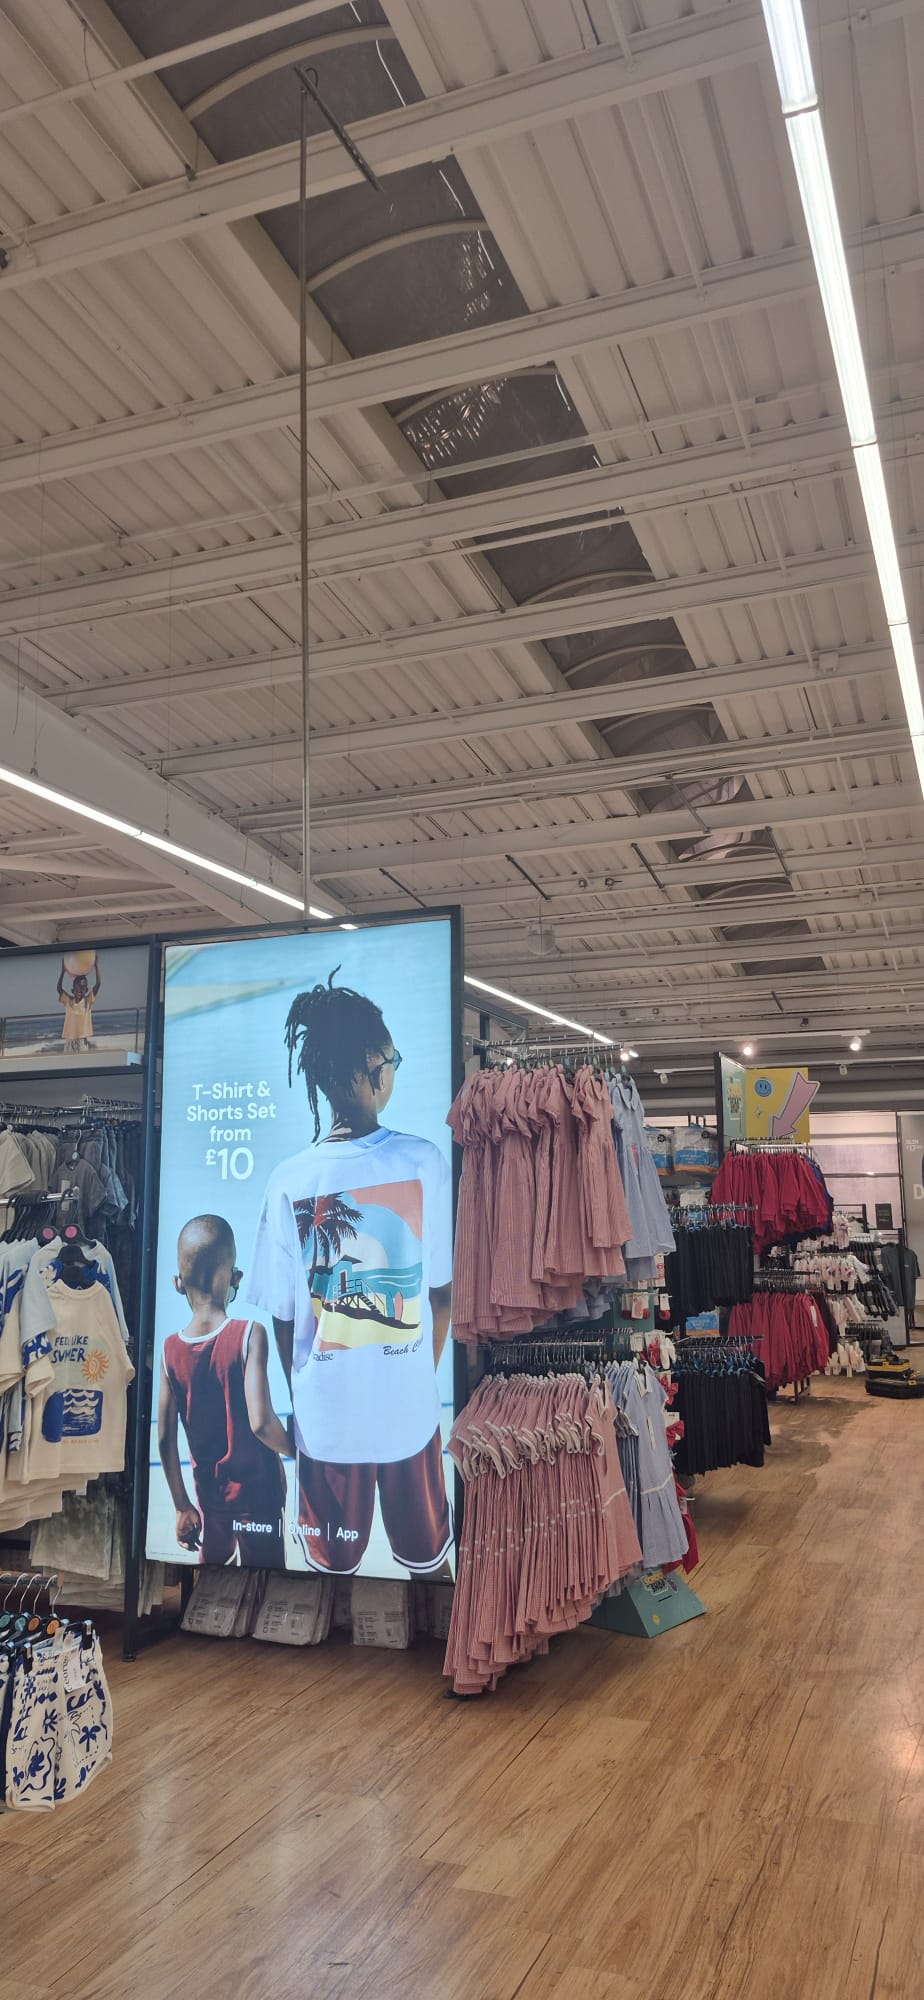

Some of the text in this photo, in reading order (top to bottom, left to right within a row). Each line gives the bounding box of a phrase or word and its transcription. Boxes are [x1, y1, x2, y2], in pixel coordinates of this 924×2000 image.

[192, 1080, 271, 1100] T-Shirt &
[187, 1103, 276, 1121] Shorts Set
[210, 1125, 251, 1142] from
[206, 1146, 254, 1180] £10
[383, 1344, 409, 1356] Beach
[232, 1519, 359, 1541] In-store Online App
